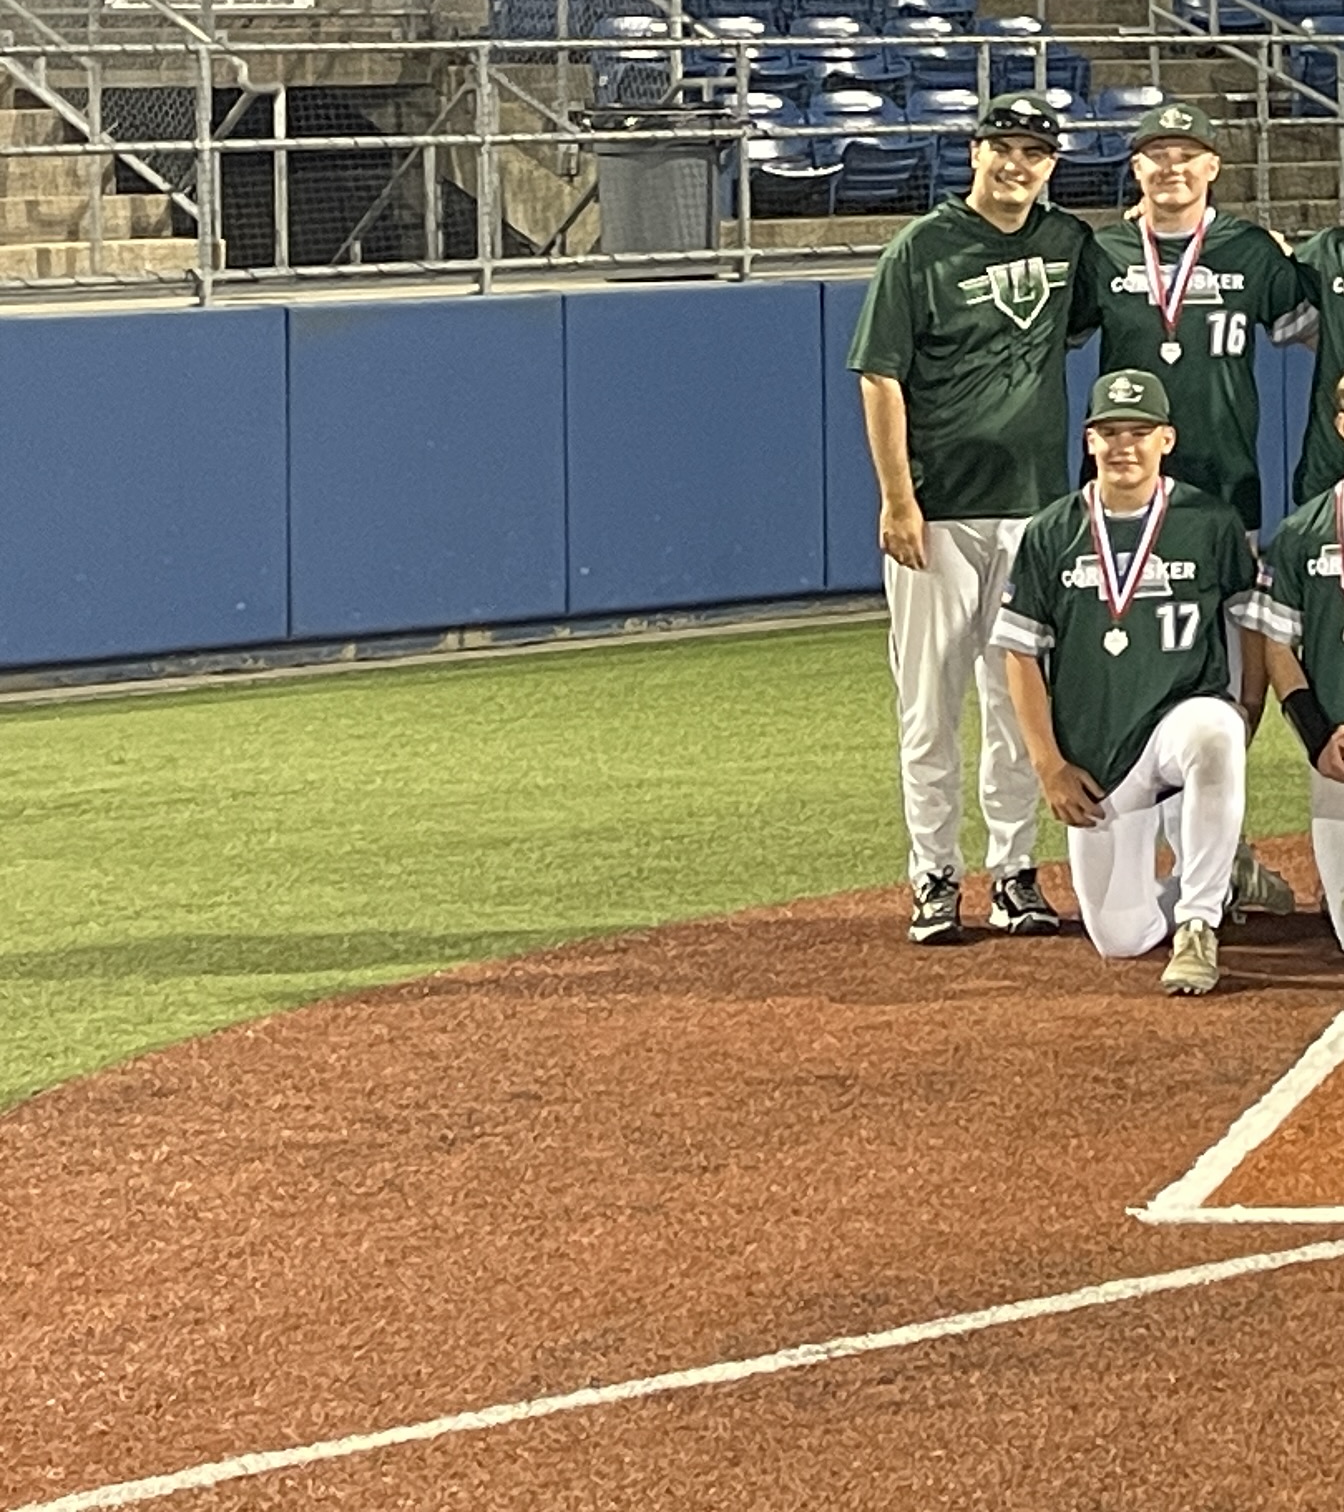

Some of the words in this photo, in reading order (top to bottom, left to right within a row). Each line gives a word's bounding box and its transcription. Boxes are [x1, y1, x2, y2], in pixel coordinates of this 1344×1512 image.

[1110, 273, 1244, 292] CORSKER
[1206, 310, 1247, 357] 16
[1061, 561, 1196, 588] CORSKER
[1156, 602, 1200, 652] 17
